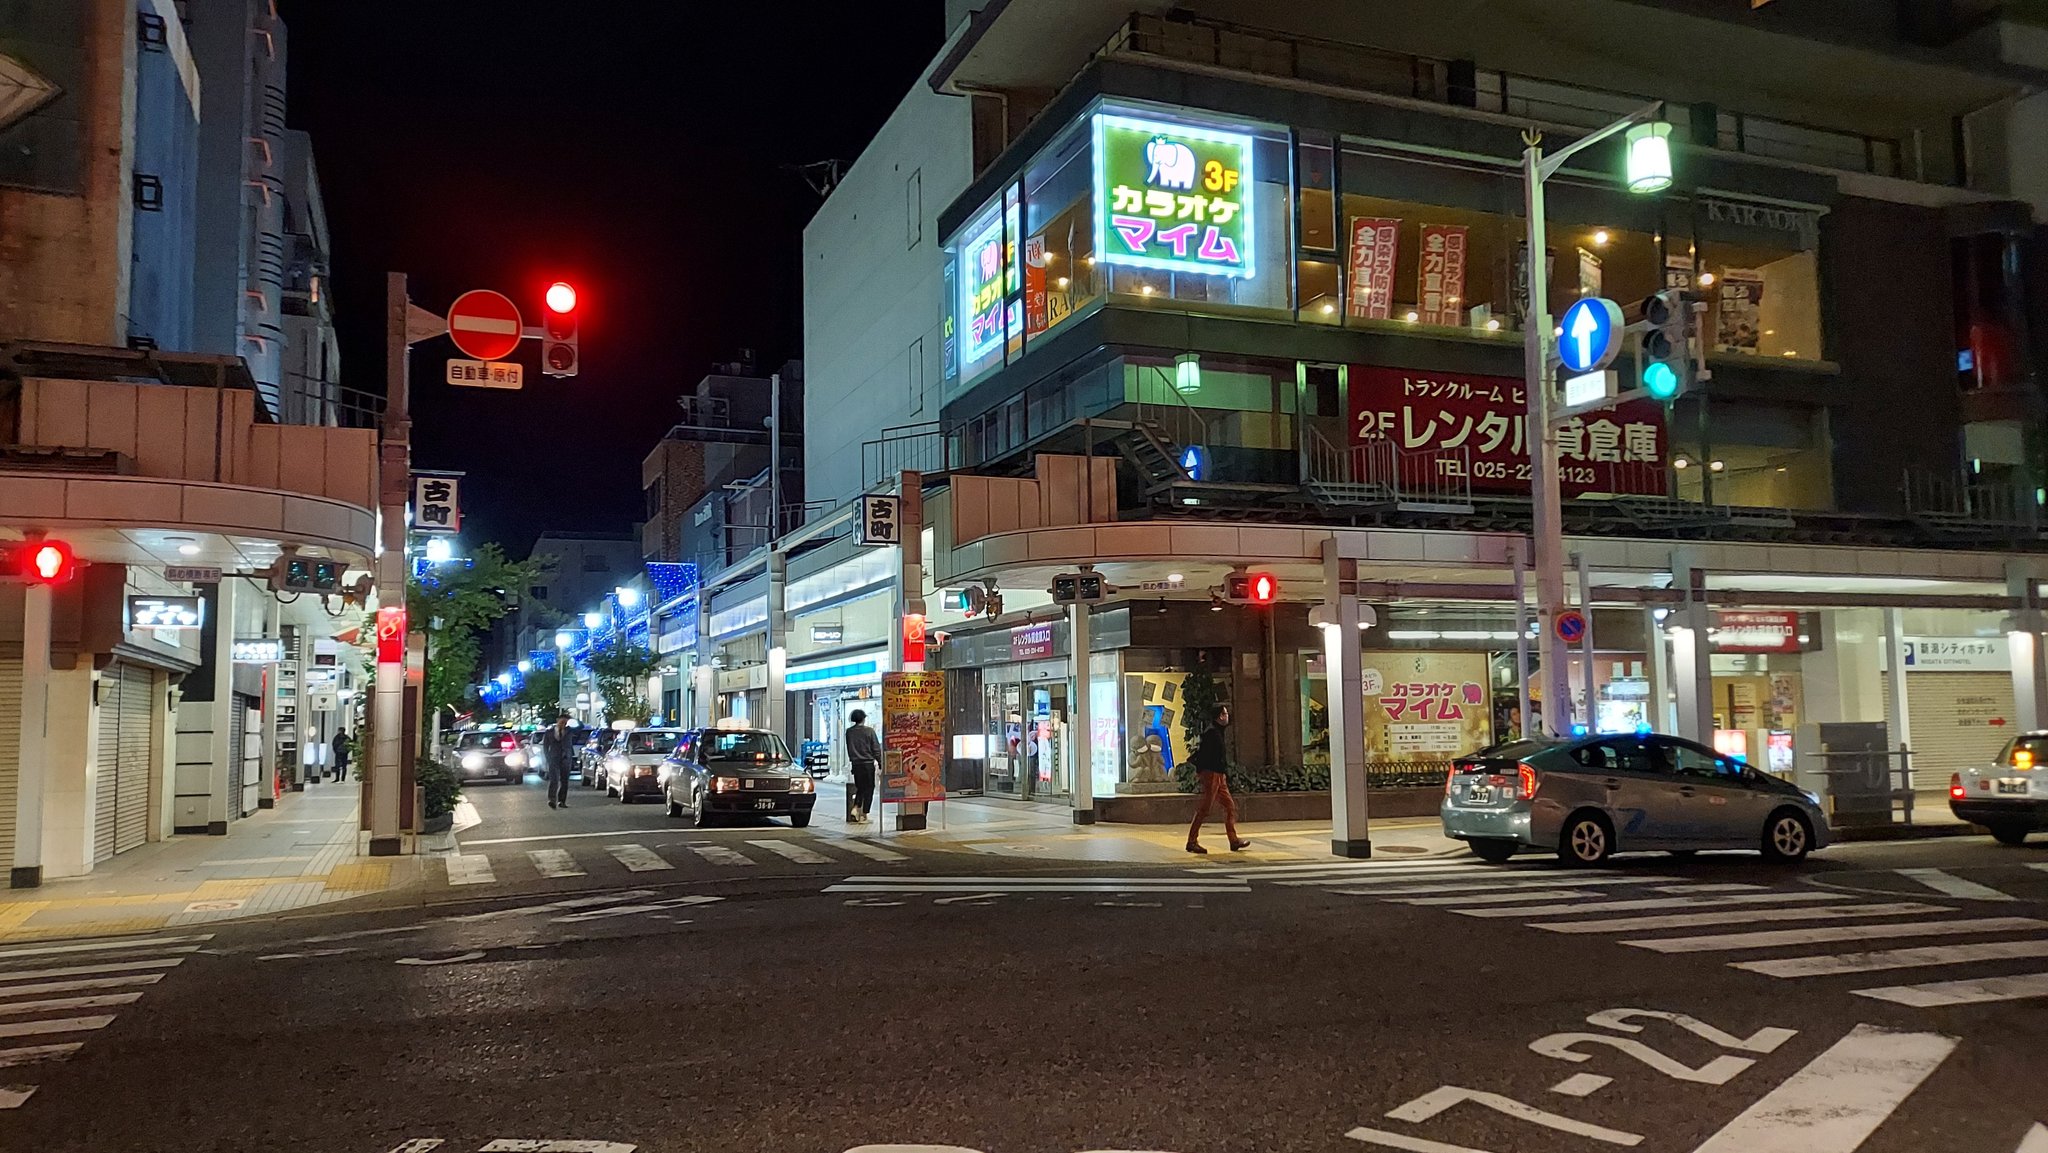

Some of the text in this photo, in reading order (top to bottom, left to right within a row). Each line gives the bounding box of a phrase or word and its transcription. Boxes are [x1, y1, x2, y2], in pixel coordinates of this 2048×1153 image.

[1204, 161, 1240, 193] 3F
[1112, 185, 1240, 223] カラオケ
[1111, 214, 1241, 263] マイム
[1403, 377, 1504, 404] トランクルーム
[1436, 456, 1468, 478] TEL
[423, 481, 452, 526] 古町
[869, 499, 894, 540] 古町
[1920, 643, 1995, 655] 新潟シティホテル
[919, 680, 942, 688] FOOD
[1391, 683, 1457, 698] カラオケ
[1379, 697, 1465, 721] マイム
